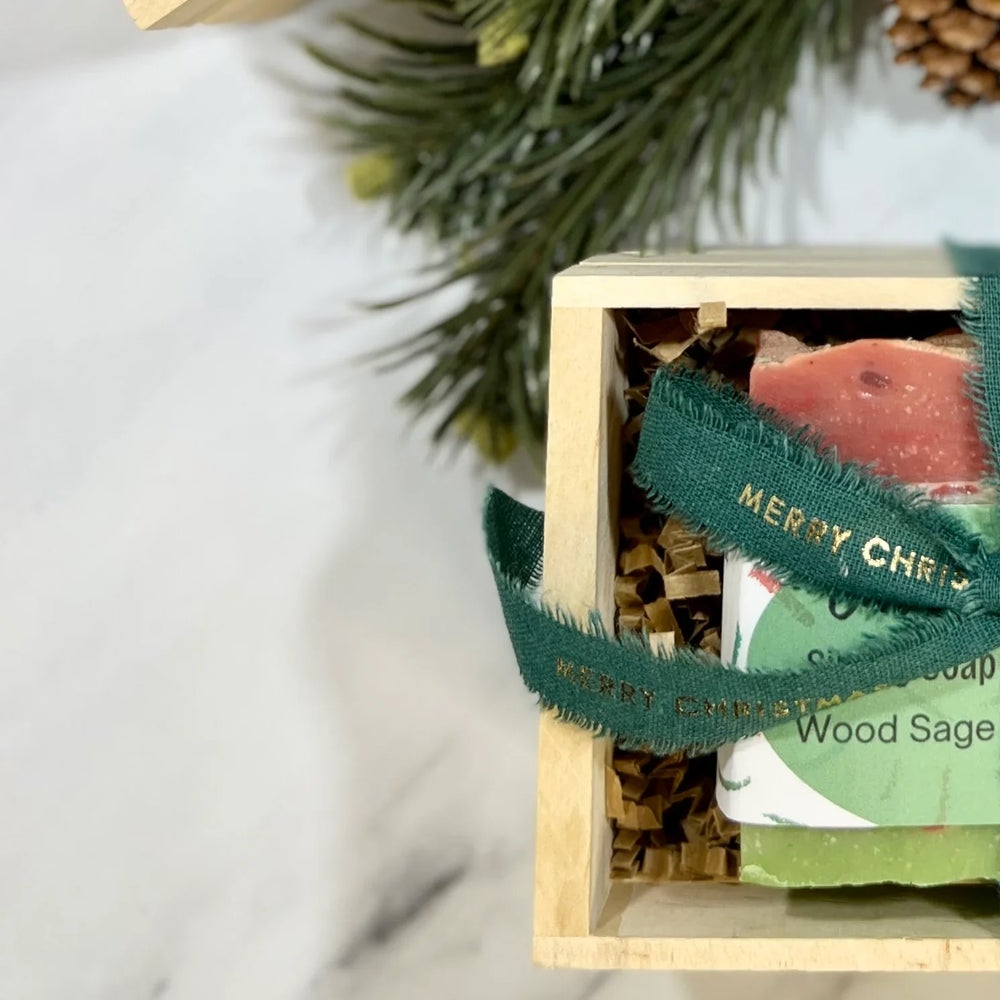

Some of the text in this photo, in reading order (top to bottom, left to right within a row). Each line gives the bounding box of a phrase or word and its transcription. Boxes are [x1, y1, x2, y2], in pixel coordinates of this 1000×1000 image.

[738, 483, 852, 554] MERRY
[556, 656, 657, 708] MERRY
[796, 712, 898, 744] Wood
[909, 712, 995, 750] Sage
